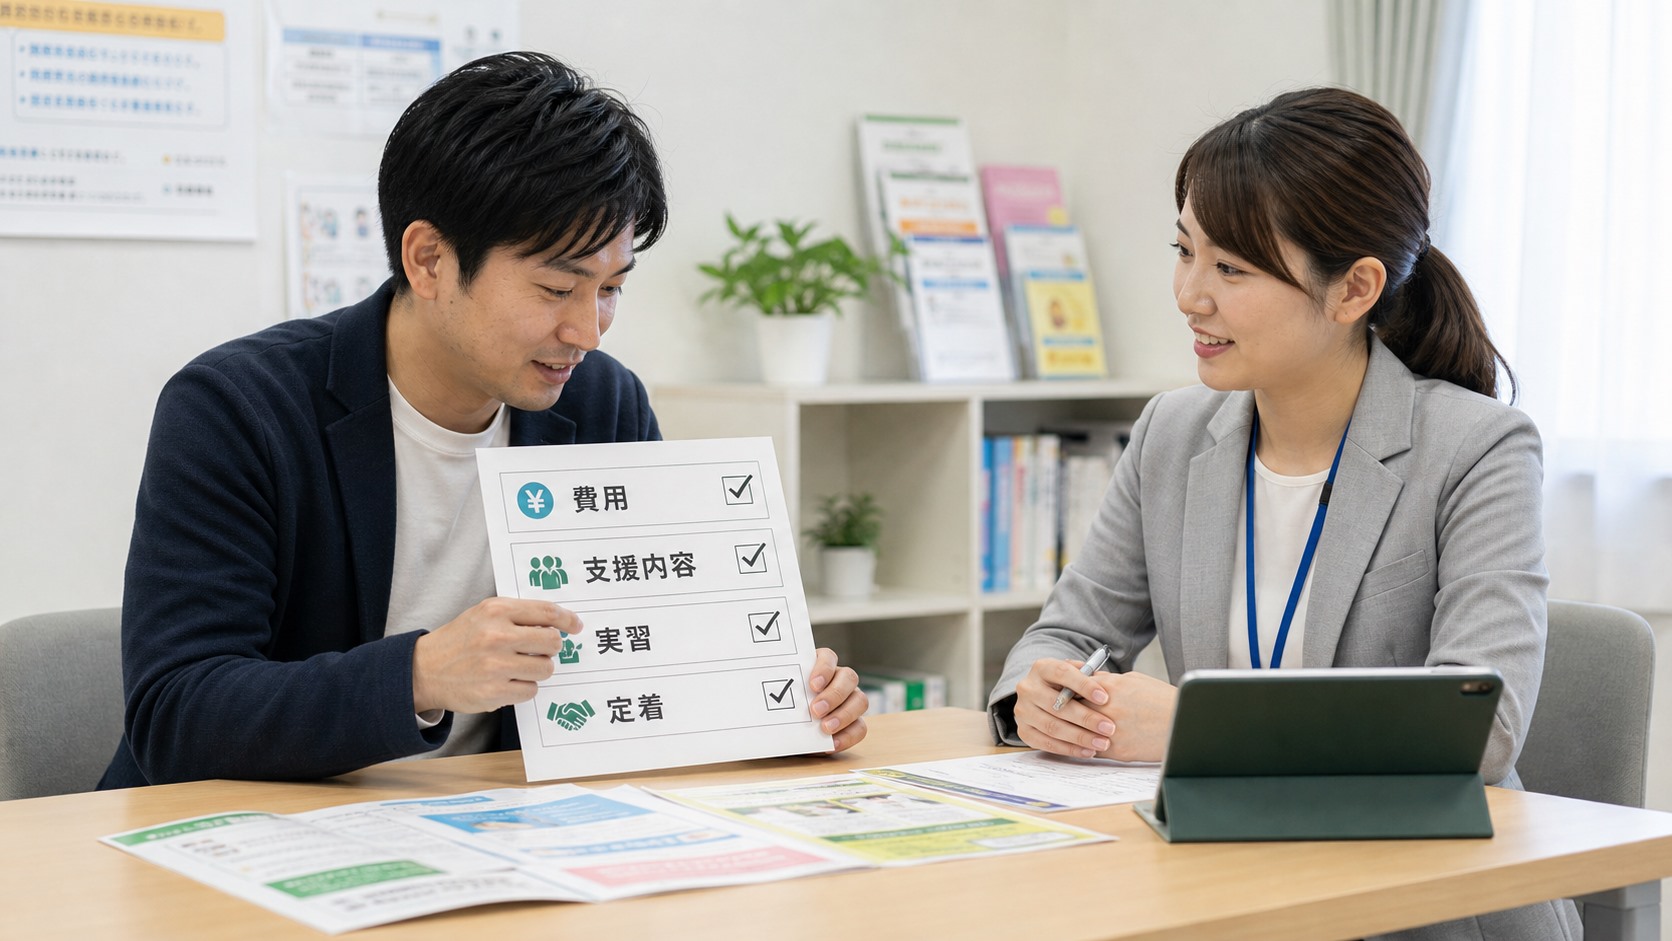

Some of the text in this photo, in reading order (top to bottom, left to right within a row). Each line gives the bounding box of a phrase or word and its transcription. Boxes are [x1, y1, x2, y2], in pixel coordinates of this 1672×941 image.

[572, 485, 629, 513] 費用
[583, 551, 697, 584] 支援内容
[595, 625, 651, 654] 実習
[606, 693, 664, 724] 定着
